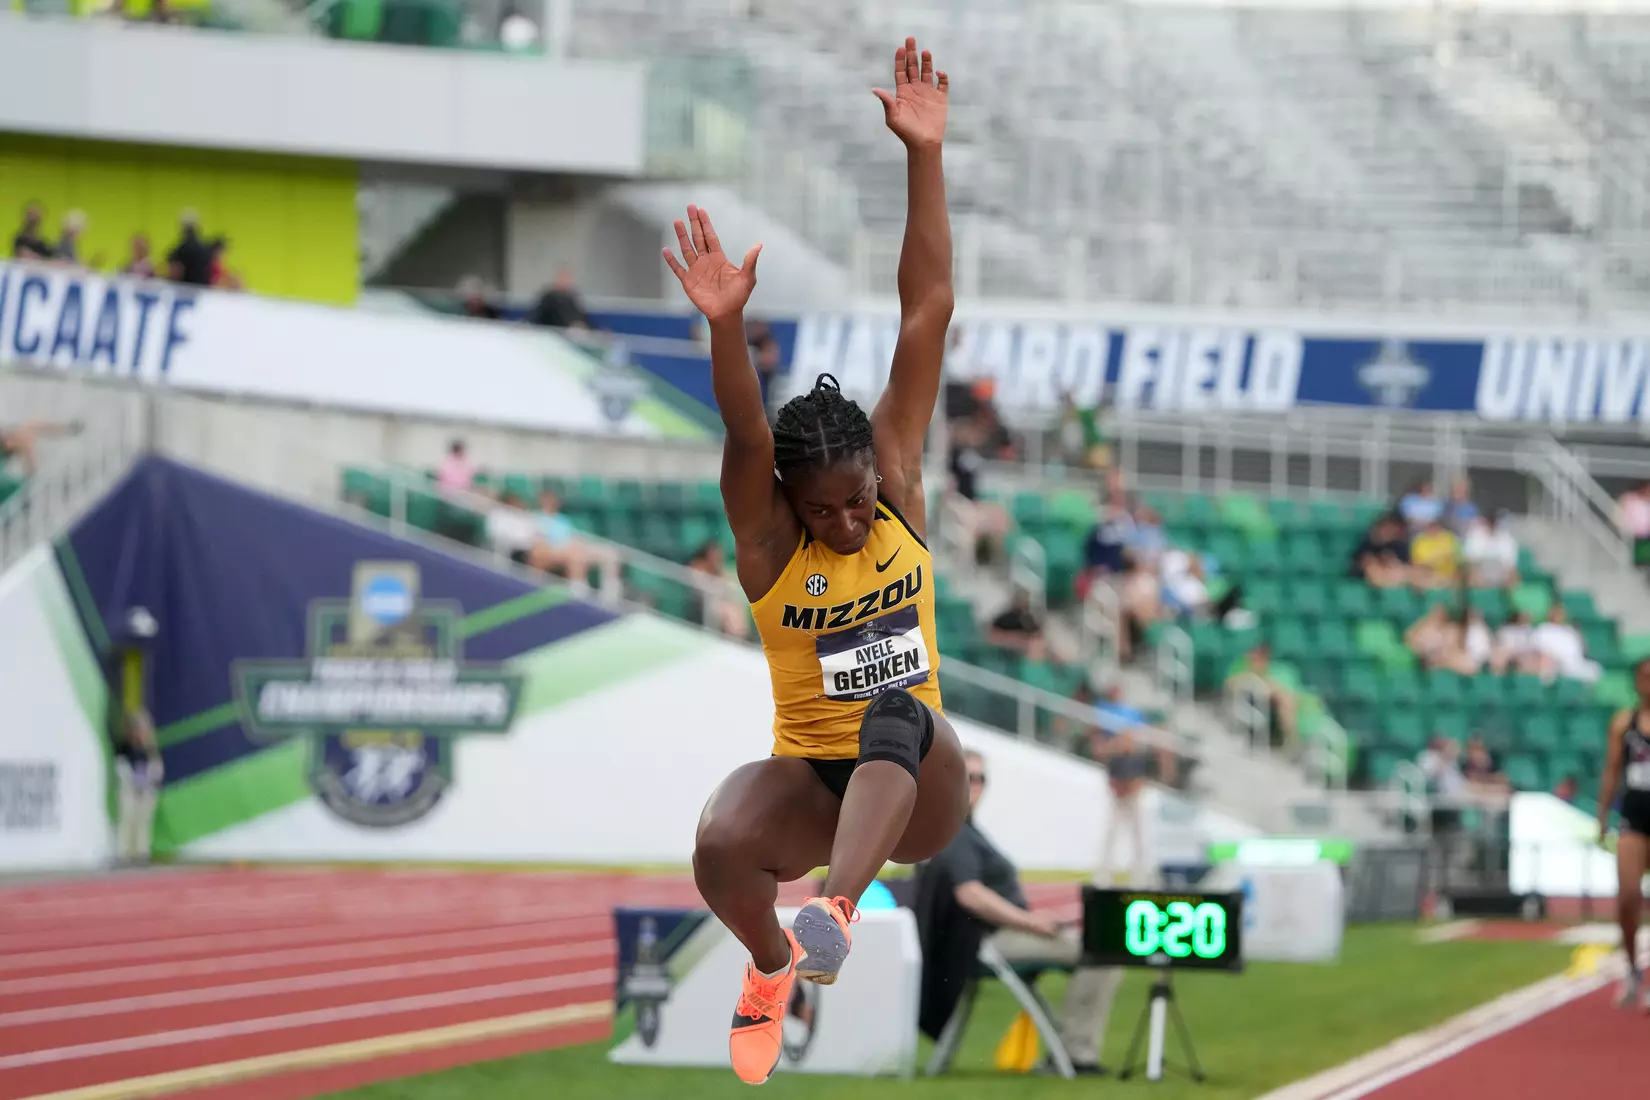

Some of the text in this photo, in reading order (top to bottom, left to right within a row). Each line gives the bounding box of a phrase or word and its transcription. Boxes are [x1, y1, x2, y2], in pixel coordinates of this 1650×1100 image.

[1114, 326, 1299, 410] FIELD
[1474, 334, 1650, 420] UNIV
[780, 563, 922, 630] MIZZOU
[806, 576, 827, 595] SEC
[833, 647, 921, 692] GERKEN
[855, 639, 895, 665] AYELE
[1125, 899, 1226, 959] 0:20
[747, 992, 774, 1014] NIKE
